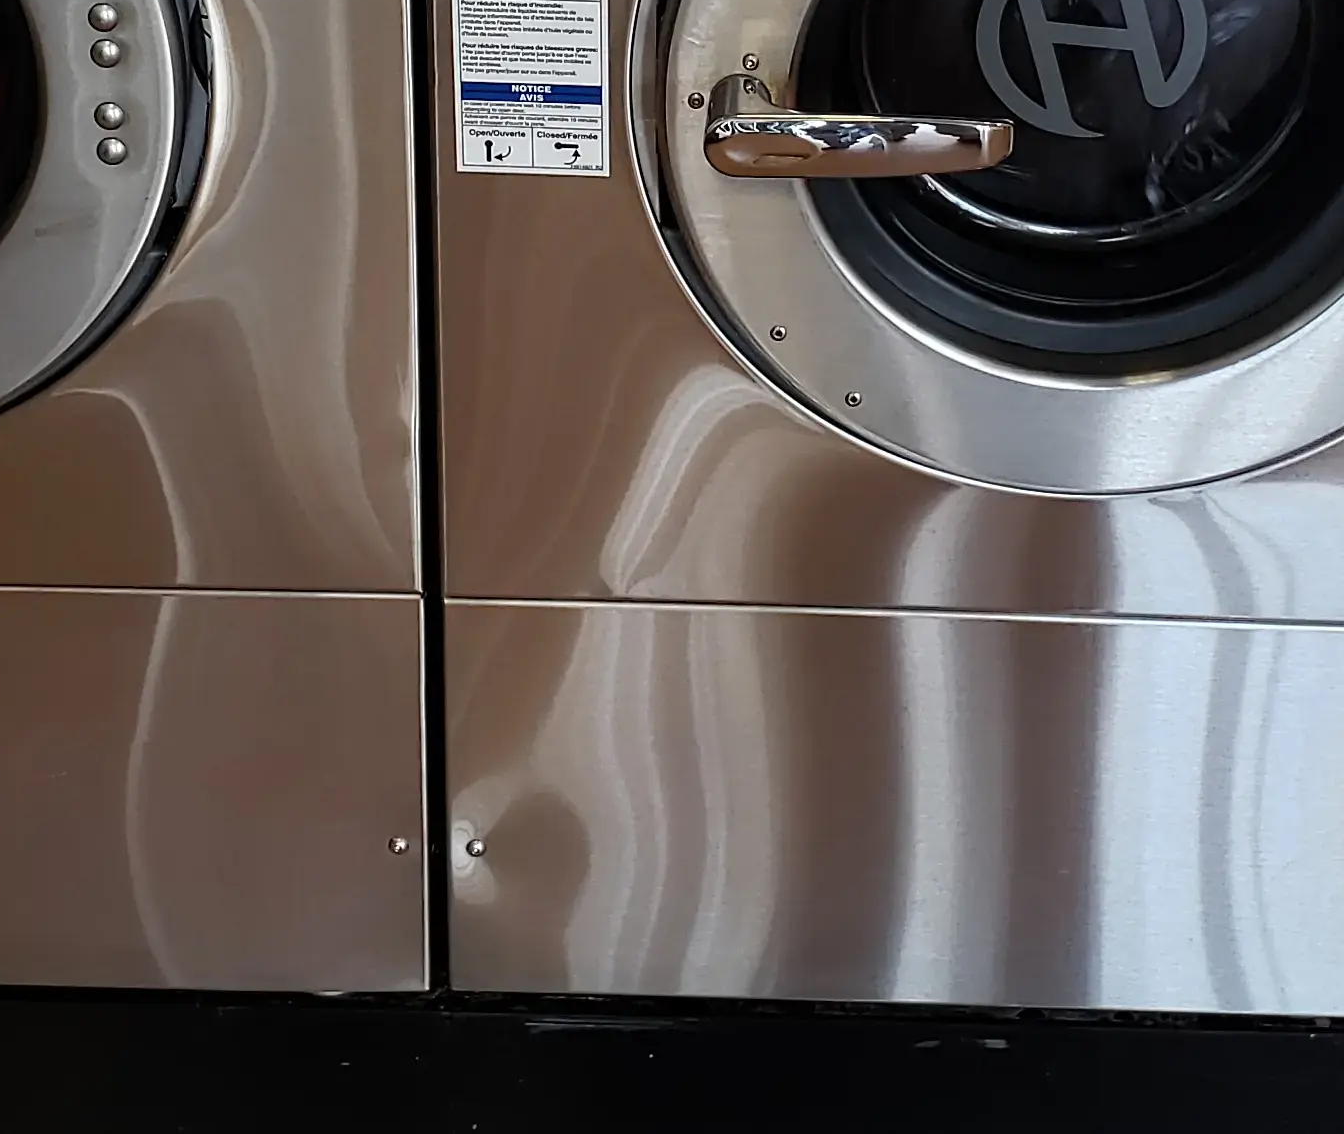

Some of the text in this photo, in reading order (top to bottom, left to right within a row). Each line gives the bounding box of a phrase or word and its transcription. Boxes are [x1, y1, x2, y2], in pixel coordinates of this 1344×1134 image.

[511, 84, 552, 93] NOTICE
[520, 94, 544, 102] AVIS
[469, 129, 525, 137] Open/Ouverte
[537, 131, 598, 140] Closed/Fermée
